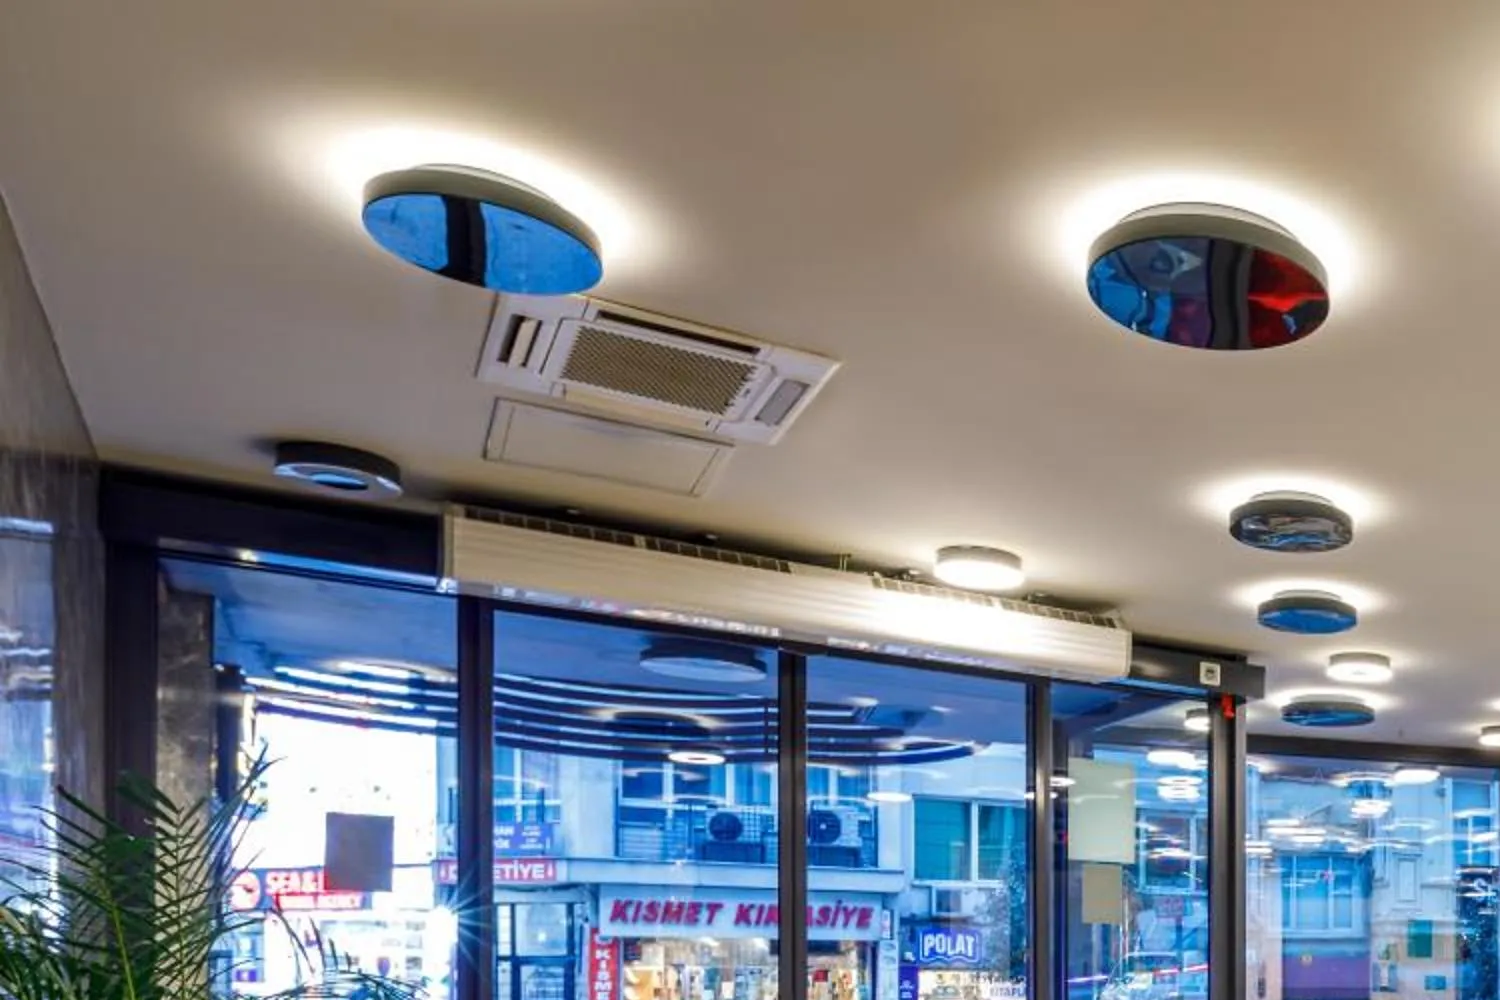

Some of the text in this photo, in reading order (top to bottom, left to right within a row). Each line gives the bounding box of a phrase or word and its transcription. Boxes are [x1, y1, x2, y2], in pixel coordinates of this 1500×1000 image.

[609, 898, 874, 928] KISMET KIRASİYE
[922, 932, 975, 958] POLAT
